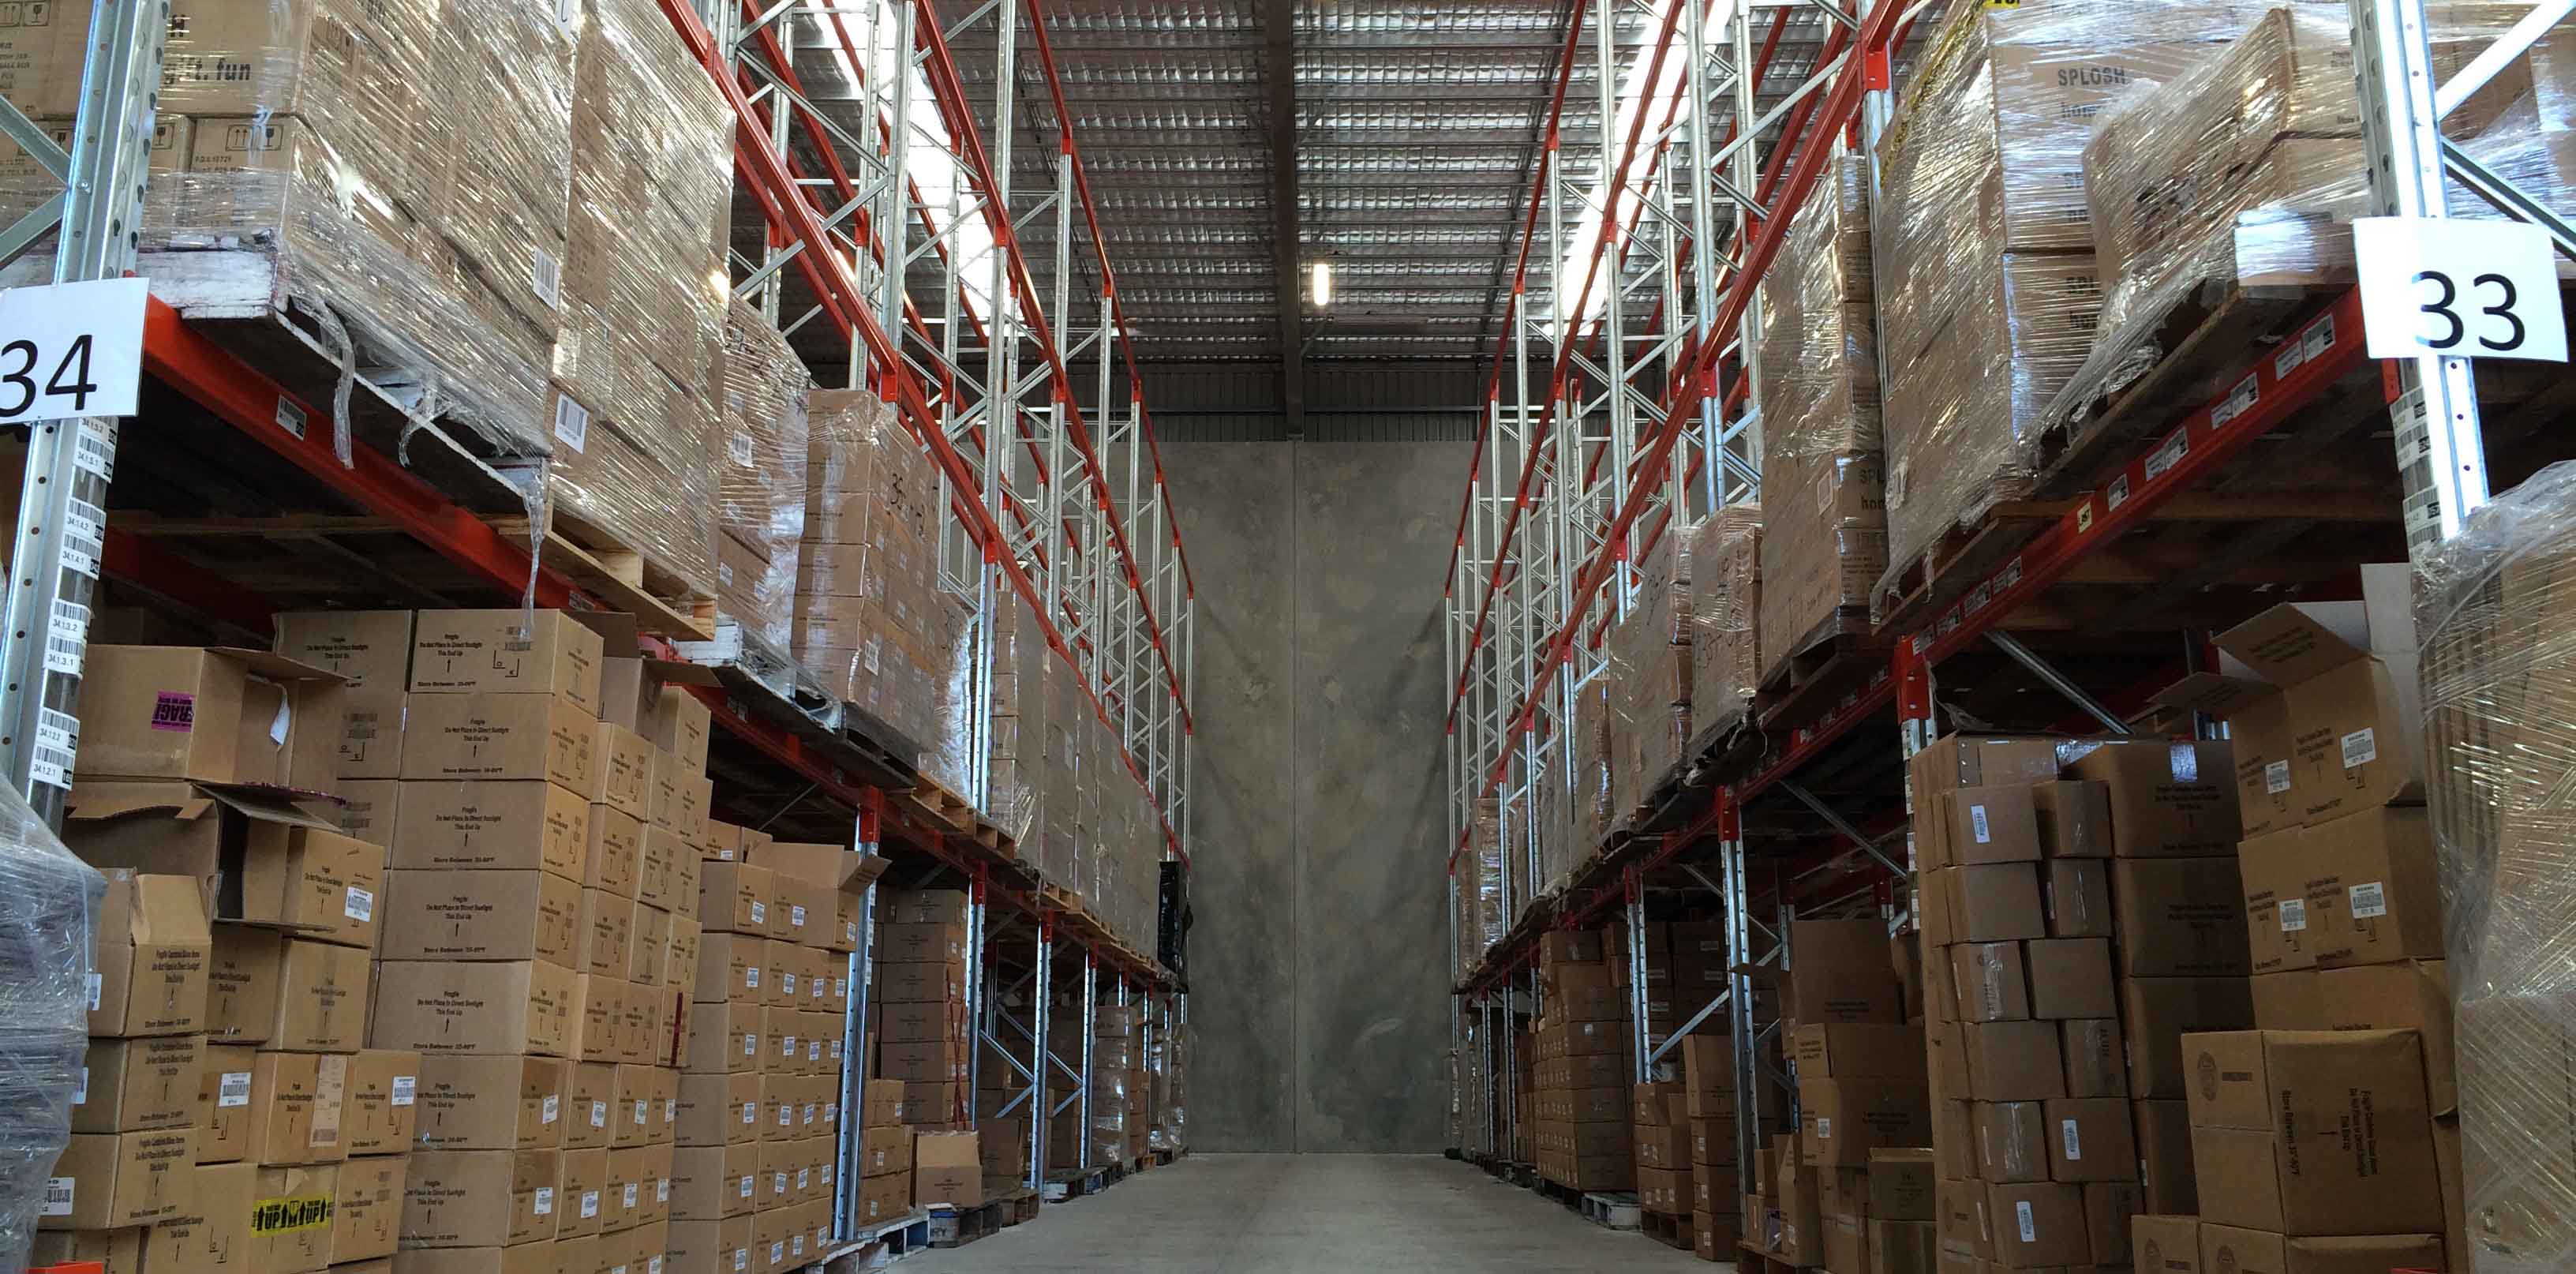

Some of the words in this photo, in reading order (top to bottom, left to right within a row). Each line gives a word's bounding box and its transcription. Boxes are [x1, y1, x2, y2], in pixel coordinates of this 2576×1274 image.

[217, 58, 251, 81] fun
[2057, 68, 2126, 88] SPLOSH
[2411, 270, 2525, 351] 33
[0, 334, 98, 418] 34
[264, 1212, 281, 1230] UP
[305, 1206, 320, 1224] UP
